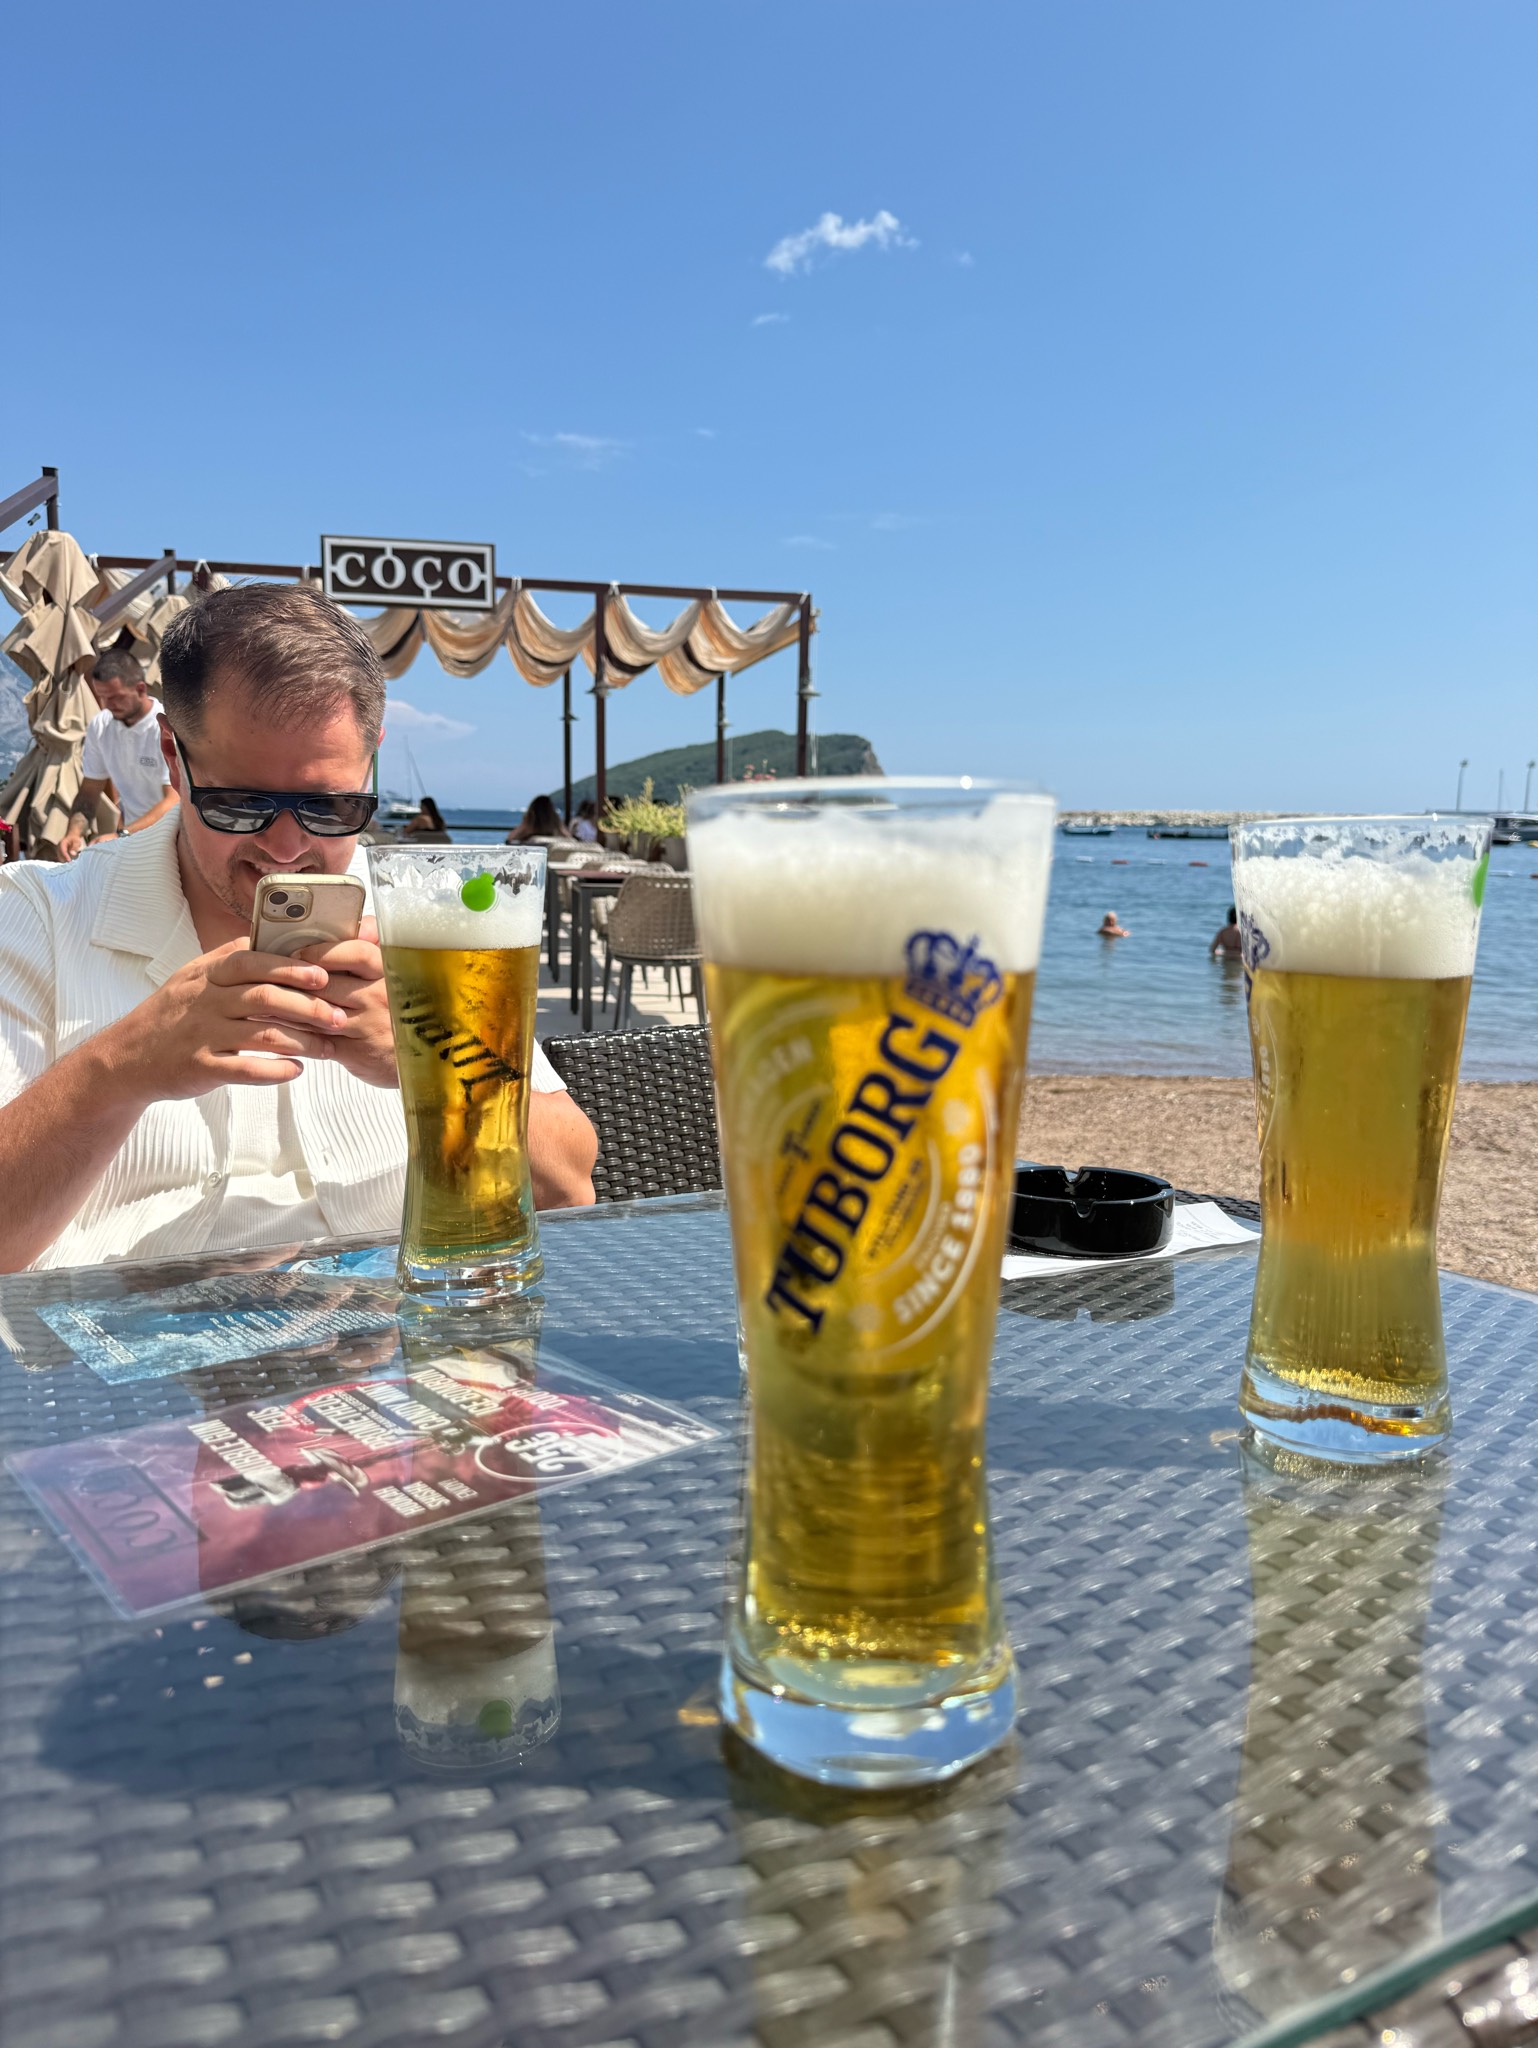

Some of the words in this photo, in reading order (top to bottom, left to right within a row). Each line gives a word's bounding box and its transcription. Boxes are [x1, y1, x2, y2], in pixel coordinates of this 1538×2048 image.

[335, 551, 483, 593] COCO
[765, 1012, 962, 1336] TUBORG
[892, 1233, 965, 1325] SINCE
[951, 1142, 983, 1231] 1880
[354, 1380, 410, 1404] MINT
[405, 1368, 482, 1402] BOMBON
[243, 1405, 300, 1432] ZEUS
[300, 1393, 404, 1450] PROMETHEUS
[385, 1399, 453, 1430] CANDY
[457, 1397, 505, 1416] ICE
[184, 1418, 240, 1444] GUM
[501, 1429, 598, 1473] 25€
[369, 1486, 428, 1519] HOOKAH
[398, 1480, 453, 1511] SHISHA
[434, 1477, 481, 1502] ENJOY!
